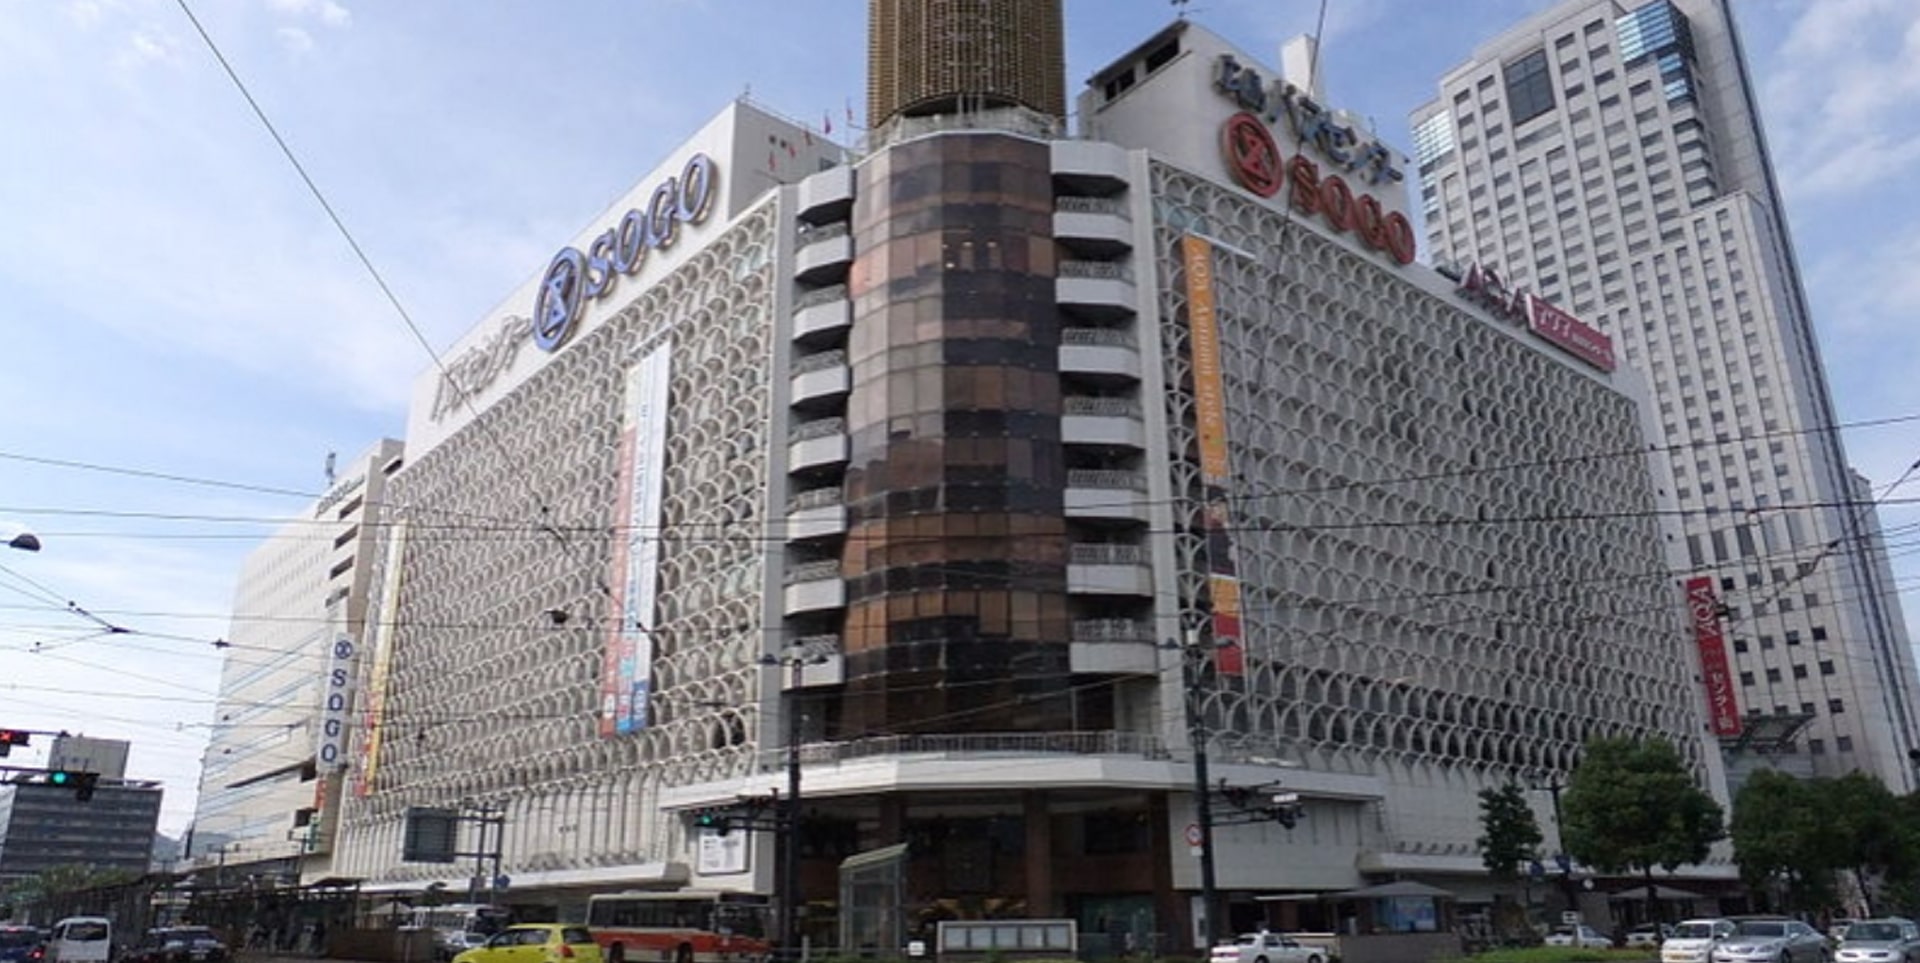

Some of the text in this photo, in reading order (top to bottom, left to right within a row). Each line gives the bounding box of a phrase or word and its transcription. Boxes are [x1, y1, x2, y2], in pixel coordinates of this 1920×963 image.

[585, 153, 718, 298] SOGO
[1288, 154, 1415, 264] SOGO
[322, 669, 346, 763] SOGO
